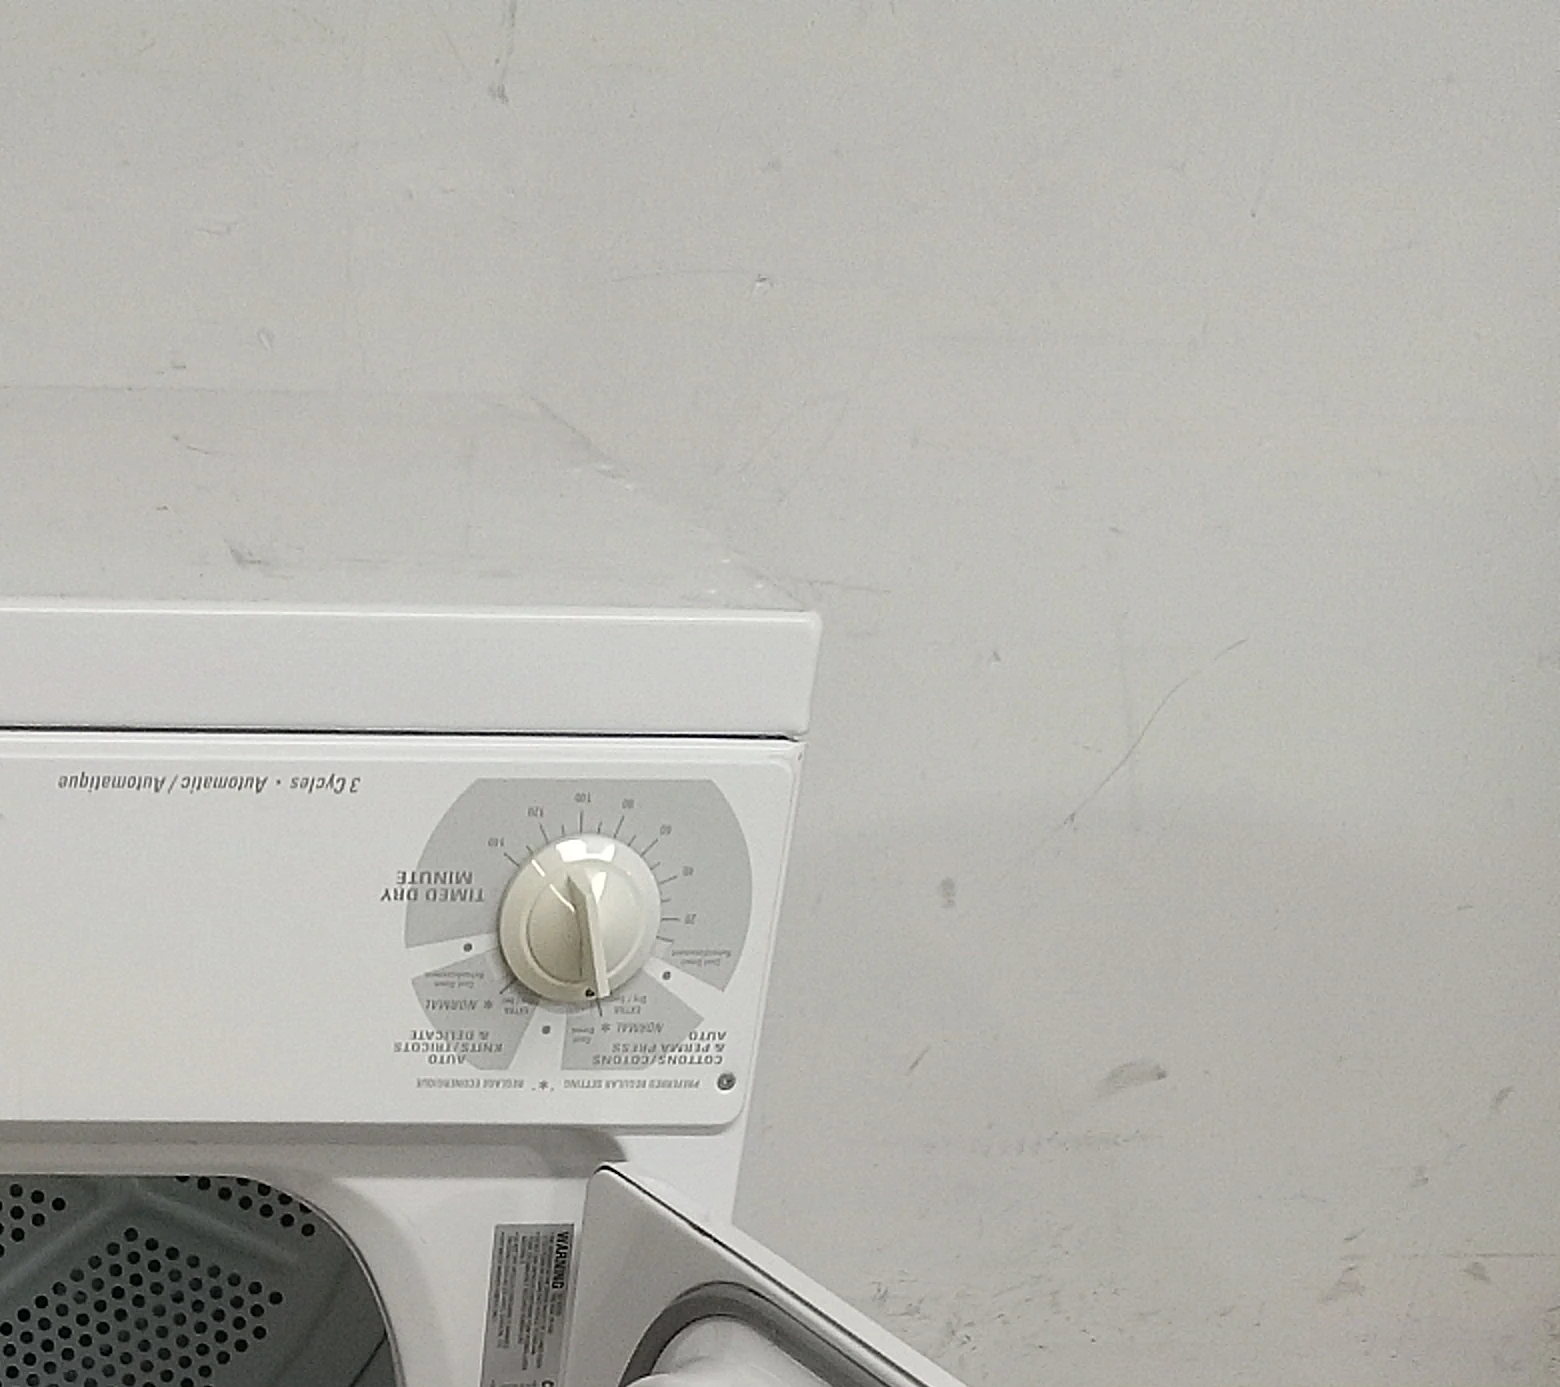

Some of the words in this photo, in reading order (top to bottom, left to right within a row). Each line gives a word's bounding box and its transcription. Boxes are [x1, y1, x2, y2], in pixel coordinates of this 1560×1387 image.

[57, 772, 166, 793] Automatique
[167, 775, 178, 794] /
[180, 776, 268, 794] Automatic
[289, 774, 346, 794] Cycles
[350, 777, 360, 794] 3
[574, 792, 591, 804] 100
[528, 806, 544, 818] 120
[488, 836, 505, 848] 140
[396, 870, 472, 884] MINUTE
[380, 887, 418, 902] DRY
[426, 888, 485, 902] TIMED
[684, 914, 696, 925] 20
[424, 999, 479, 1010] NORMAL
[616, 1022, 664, 1033] NORMAL
[409, 1030, 474, 1040] DELICATE
[479, 1030, 490, 1040] &
[688, 1031, 727, 1041] AUTO
[393, 1042, 502, 1053] KNITS/TRICOTS
[611, 1042, 656, 1052] PRESS
[661, 1043, 710, 1052] PERMA
[715, 1043, 725, 1052] &
[428, 1054, 466, 1064] AUTO
[592, 1055, 723, 1065] COTTONS/COTONS
[563, 1080, 602, 1088] SETTING
[605, 1080, 646, 1088] REGULAR
[648, 1080, 700, 1088] PREFERRED
[552, 1231, 570, 1290] WARNING
